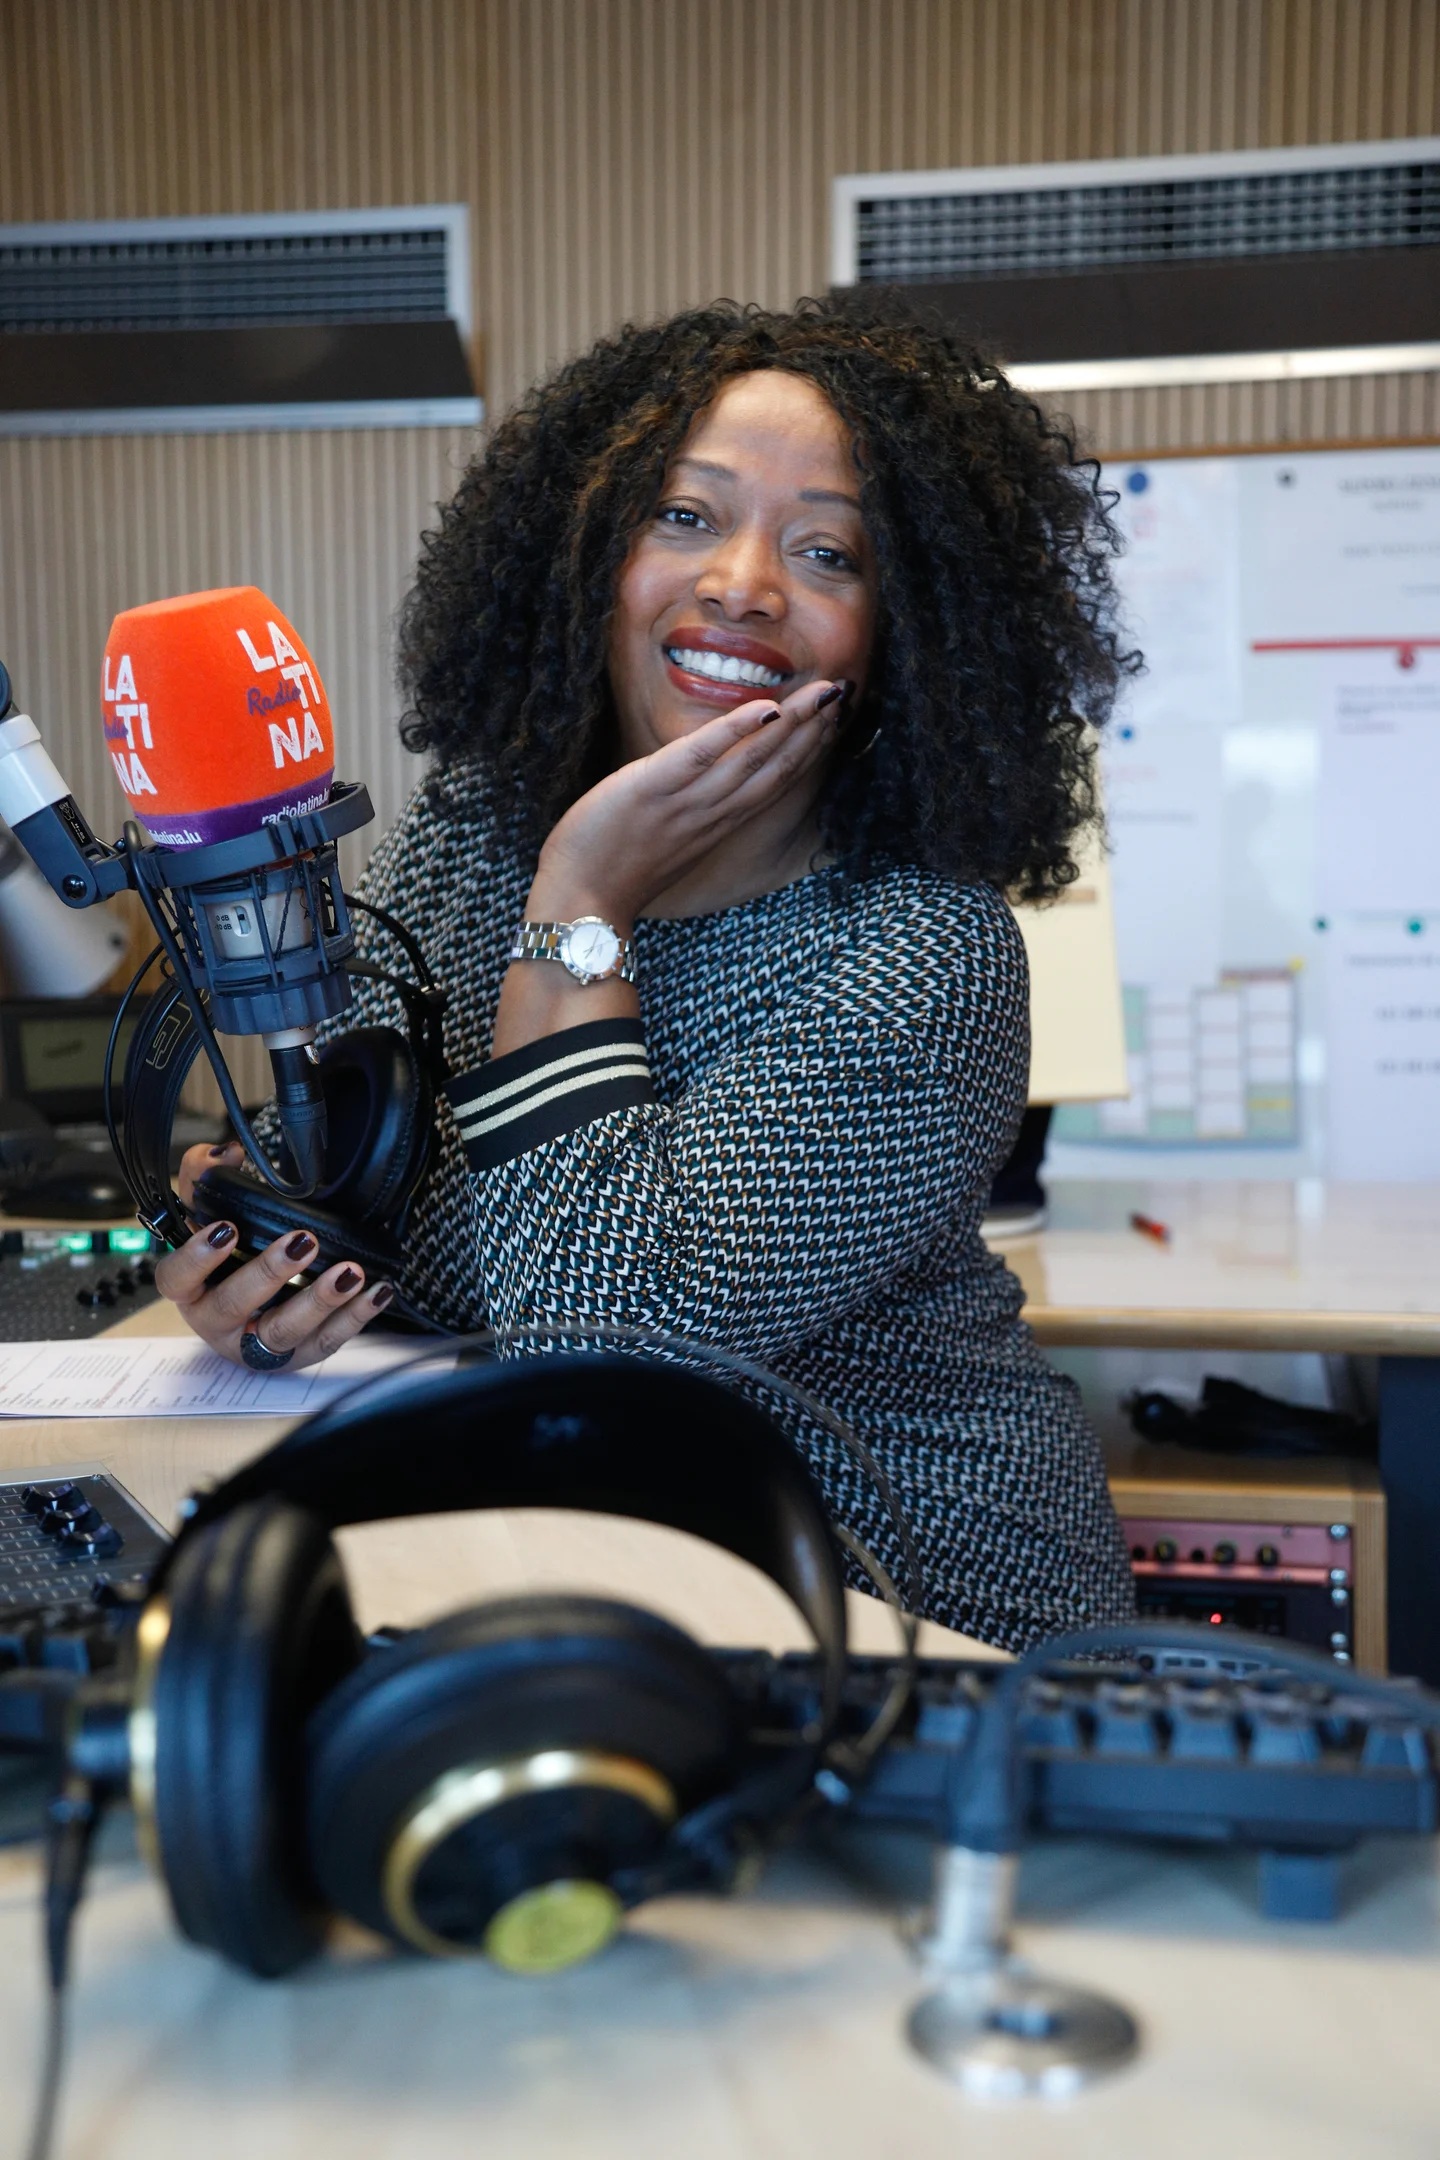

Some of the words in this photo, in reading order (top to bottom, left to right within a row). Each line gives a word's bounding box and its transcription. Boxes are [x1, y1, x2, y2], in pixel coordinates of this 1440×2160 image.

[236, 621, 300, 672] LA
[104, 655, 138, 701] LA
[247, 681, 301, 715] Radio
[280, 661, 321, 709] TI
[116, 703, 153, 749] TI
[268, 712, 324, 768] NA
[111, 752, 158, 795] NA
